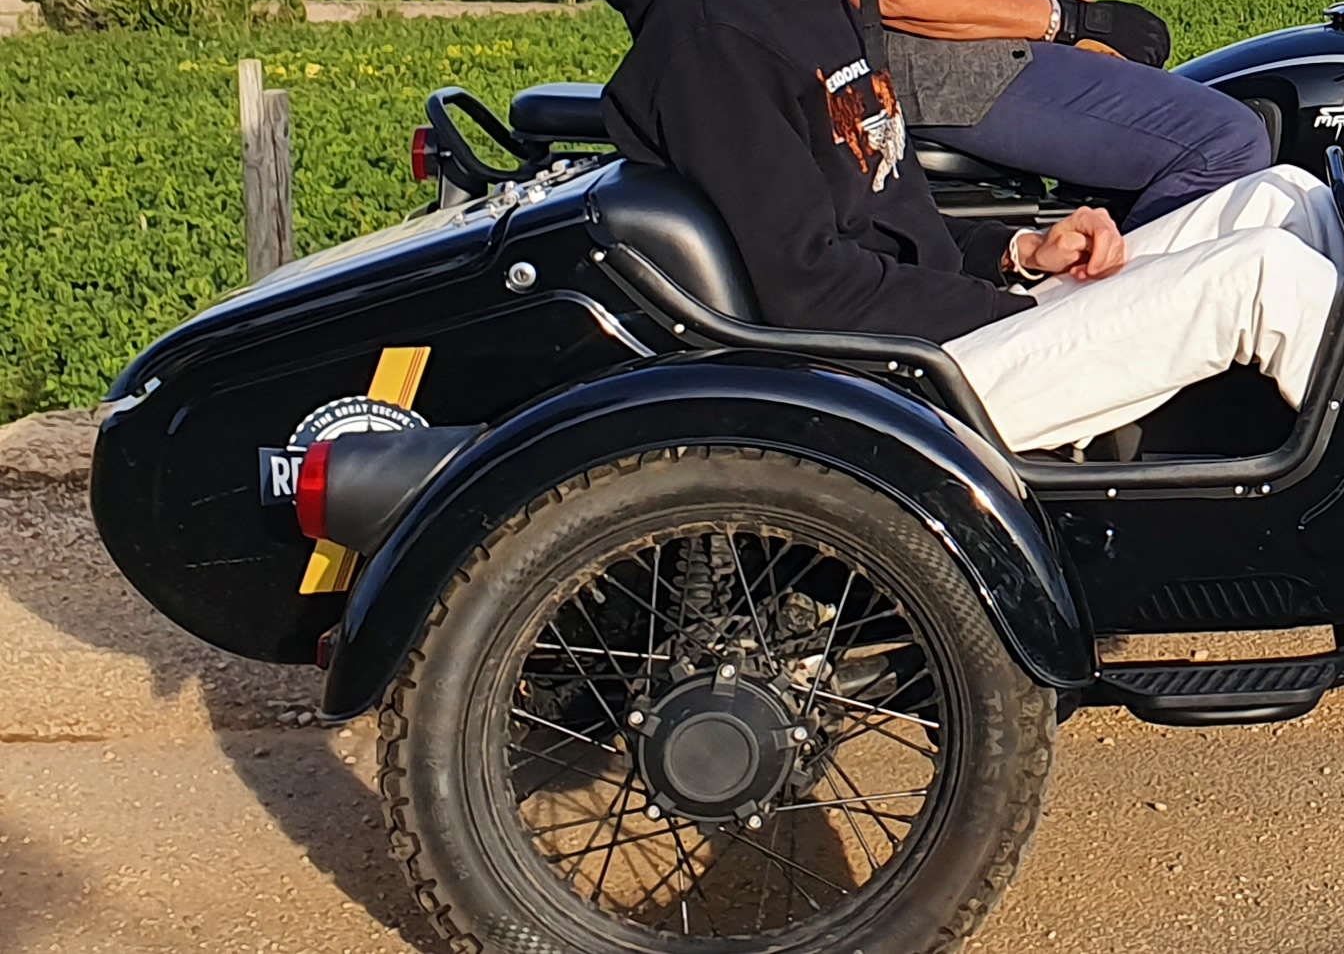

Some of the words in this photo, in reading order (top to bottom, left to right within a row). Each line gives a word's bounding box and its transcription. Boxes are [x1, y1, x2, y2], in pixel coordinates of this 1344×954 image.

[314, 413, 333, 429] THE
[335, 403, 369, 419] GREAT
[371, 403, 411, 426] ESCAPE
